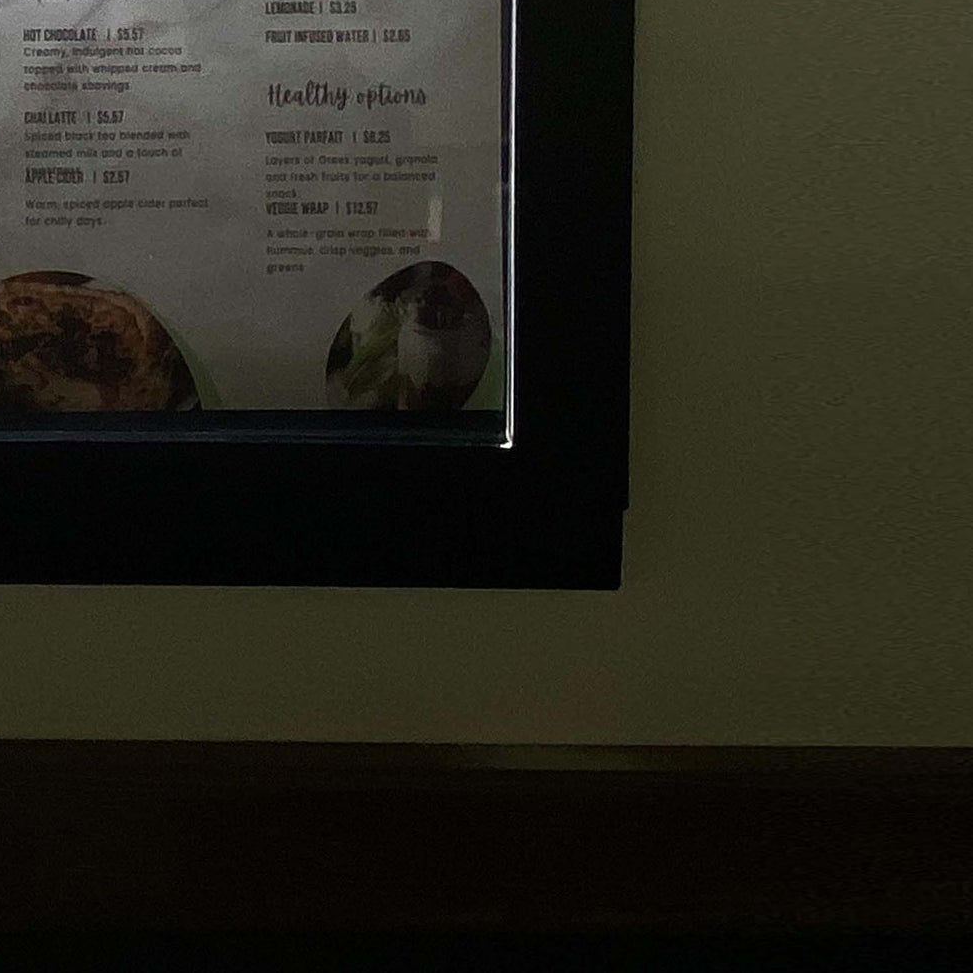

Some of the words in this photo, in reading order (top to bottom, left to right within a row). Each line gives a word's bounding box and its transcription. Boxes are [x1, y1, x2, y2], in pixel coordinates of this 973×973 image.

[265, 2, 315, 15] LEMONADE
[23, 29, 41, 42] HOT
[44, 28, 96, 41] CHOCOLATE
[265, 30, 292, 43] FRUIT
[294, 30, 333, 43] INFUSED
[336, 30, 369, 42] WATER
[267, 80, 350, 110] Healthy
[356, 82, 426, 110] options
[24, 112, 46, 124] CHAI
[49, 111, 76, 124] LATTE
[266, 131, 301, 144] YOGURT
[304, 131, 343, 144] PARFAIT
[266, 202, 298, 215] VEGGIE
[301, 202, 329, 215] WRAP
